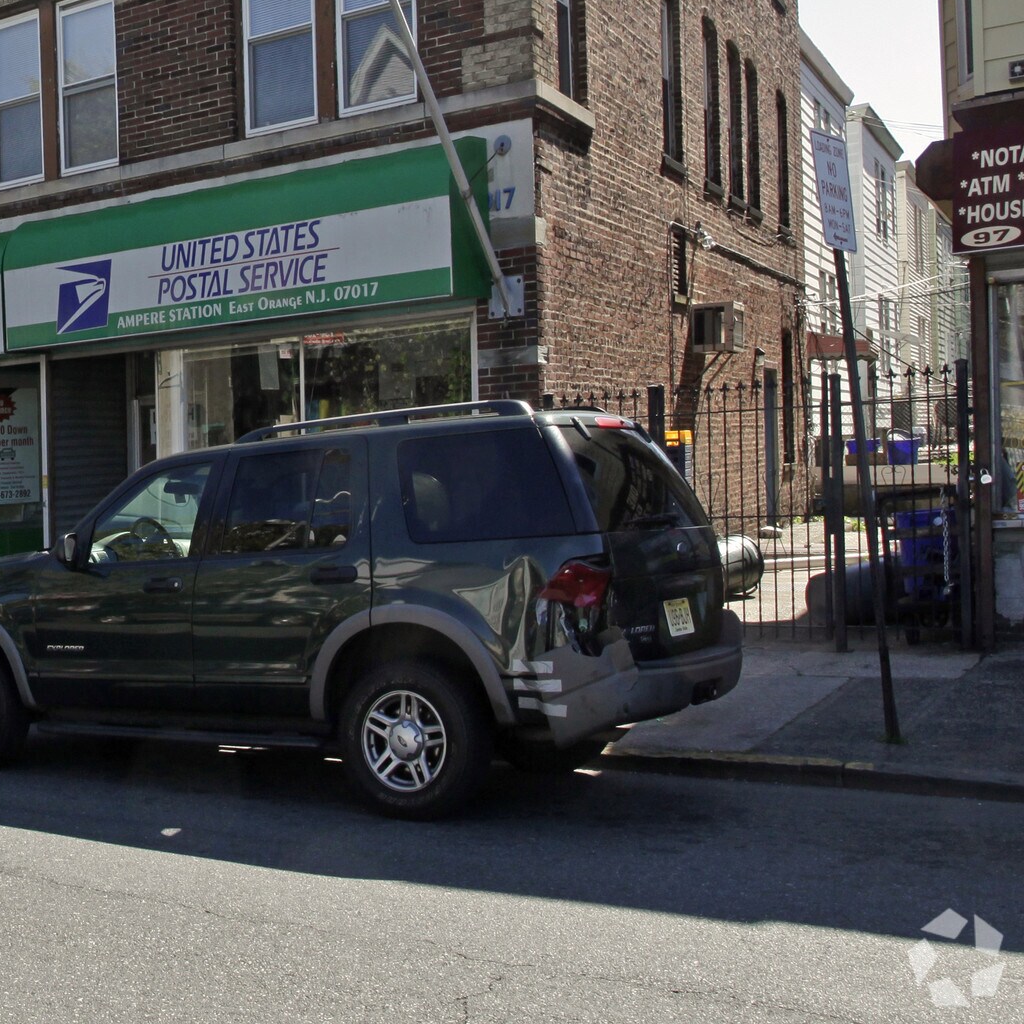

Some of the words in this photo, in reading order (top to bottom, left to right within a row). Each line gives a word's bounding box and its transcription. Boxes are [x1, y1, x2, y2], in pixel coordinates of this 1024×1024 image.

[826, 161, 837, 178] NO
[821, 180, 848, 203] PARKING
[161, 234, 239, 272] UNITED
[242, 219, 321, 259] STATES
[973, 228, 1010, 245] 97
[157, 268, 234, 304] POSTAL
[237, 253, 328, 294] SERVICE
[117, 310, 166, 329] AMPERE
[169, 303, 222, 322] STATION
[305, 288, 330, 304] N.J.
[333, 282, 379, 301] 07017
[7, 424, 28, 435] Down
[11, 436, 34, 447] month
